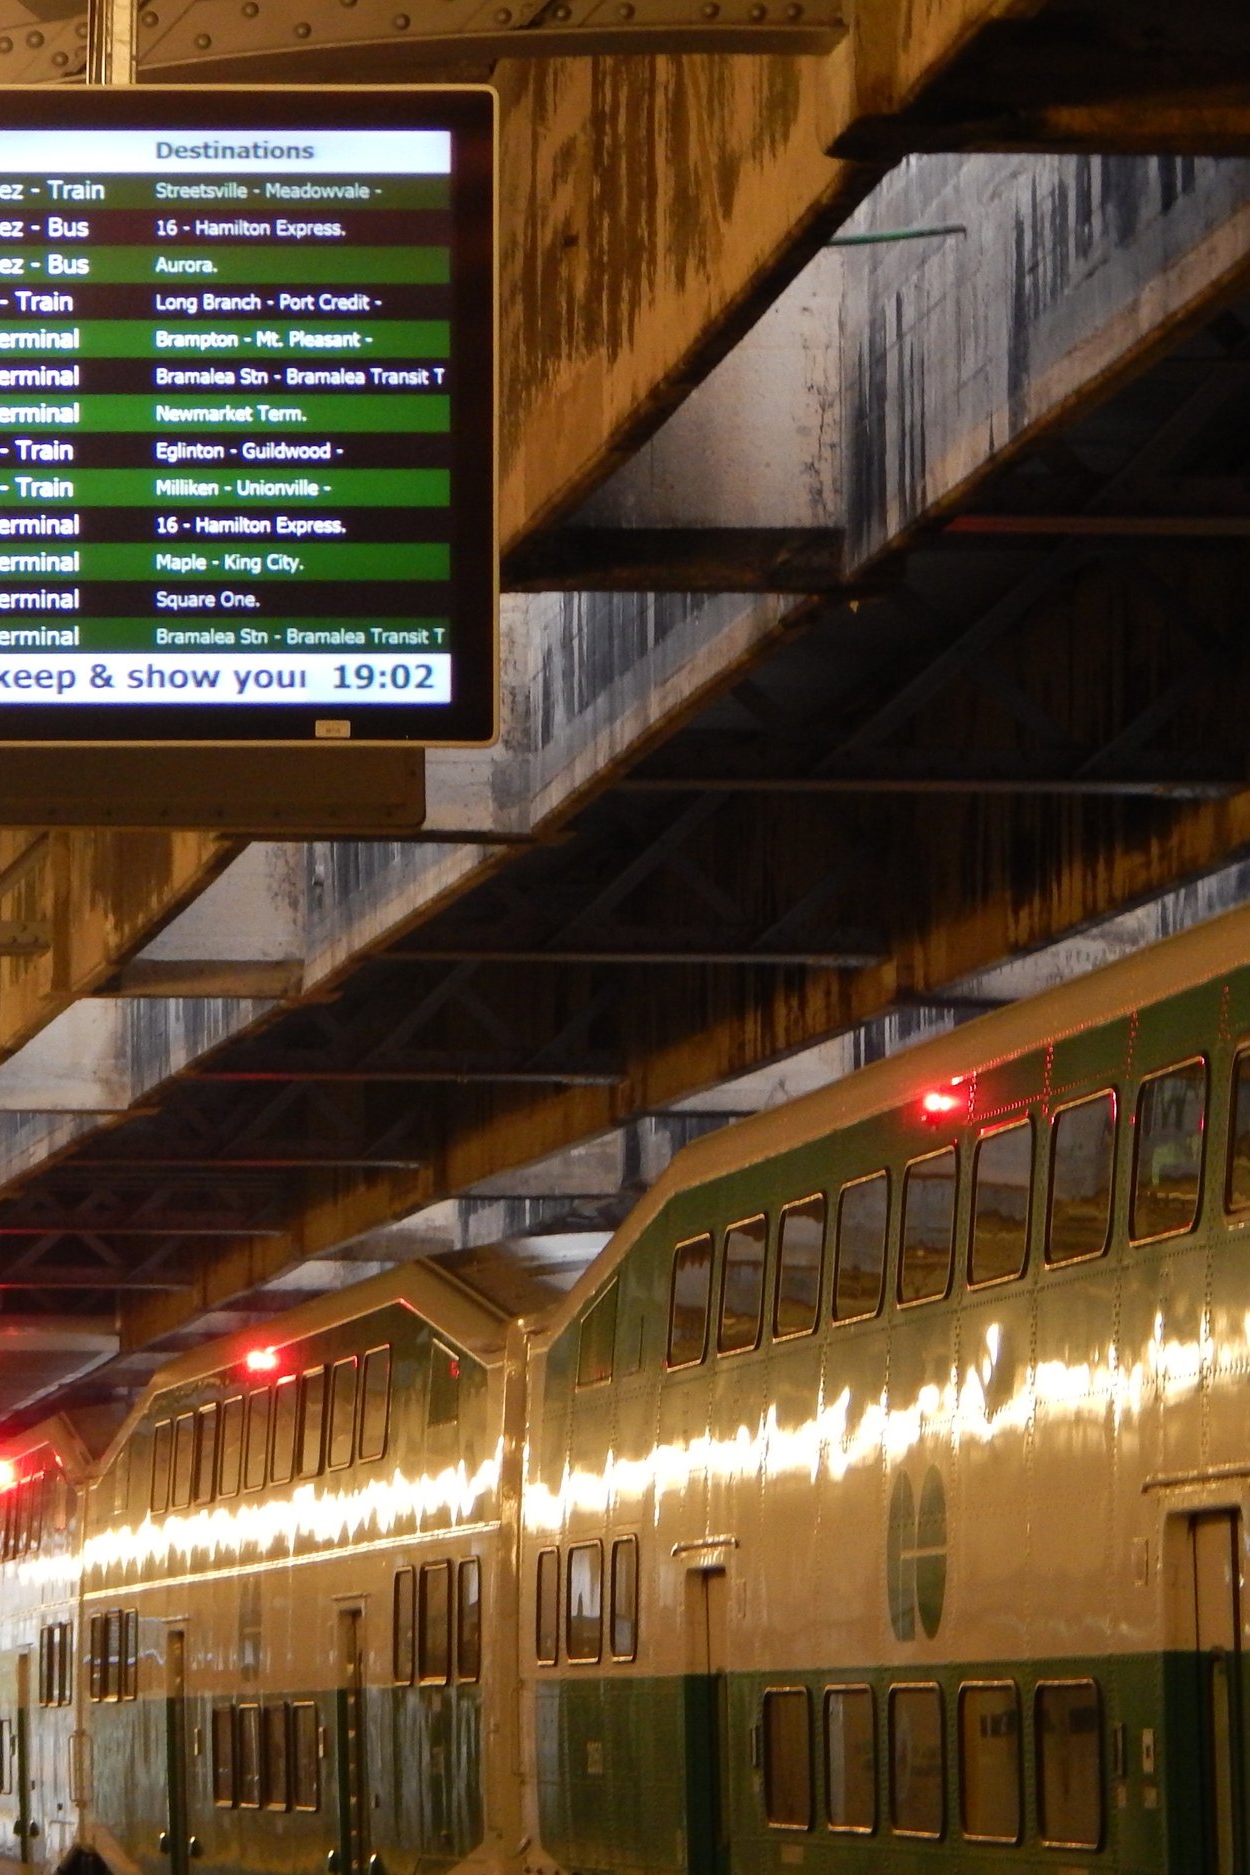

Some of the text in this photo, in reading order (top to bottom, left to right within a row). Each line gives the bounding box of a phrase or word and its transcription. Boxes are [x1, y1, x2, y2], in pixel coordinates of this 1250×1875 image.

[156, 140, 315, 160] Destinations
[46, 179, 105, 200] Train
[155, 181, 371, 199] Streetsville Meadowvale
[48, 216, 90, 238] Bus
[157, 219, 346, 239] 16 Hamilton Express.
[48, 253, 90, 275] Bus
[155, 256, 218, 274] Aurora.
[14, 290, 74, 312] Train
[156, 293, 370, 315] Long Branch Port Credit
[155, 330, 362, 351] Brampton Mt. Pleasant
[156, 367, 236, 385] Bramalea
[240, 367, 269, 385] Stn
[286, 367, 366, 385] Bramalea
[369, 367, 430, 385] Transit
[156, 404, 307, 422] Newmarket Term.
[14, 439, 74, 461] Train
[156, 441, 332, 463] Eglinton Guildwood
[14, 476, 74, 498] Train
[156, 478, 320, 497] Milliken Unionville
[157, 515, 347, 537] 16 Hamilton Express.
[156, 553, 304, 575] Maple King City.
[156, 590, 261, 611] Square One.
[156, 627, 236, 645] Bramalea
[240, 627, 269, 645] Stn
[286, 627, 366, 645] Bramalea
[370, 627, 429, 645] Transit
[89, 663, 115, 689] &
[127, 663, 221, 689] show
[334, 663, 434, 690] 19:02
